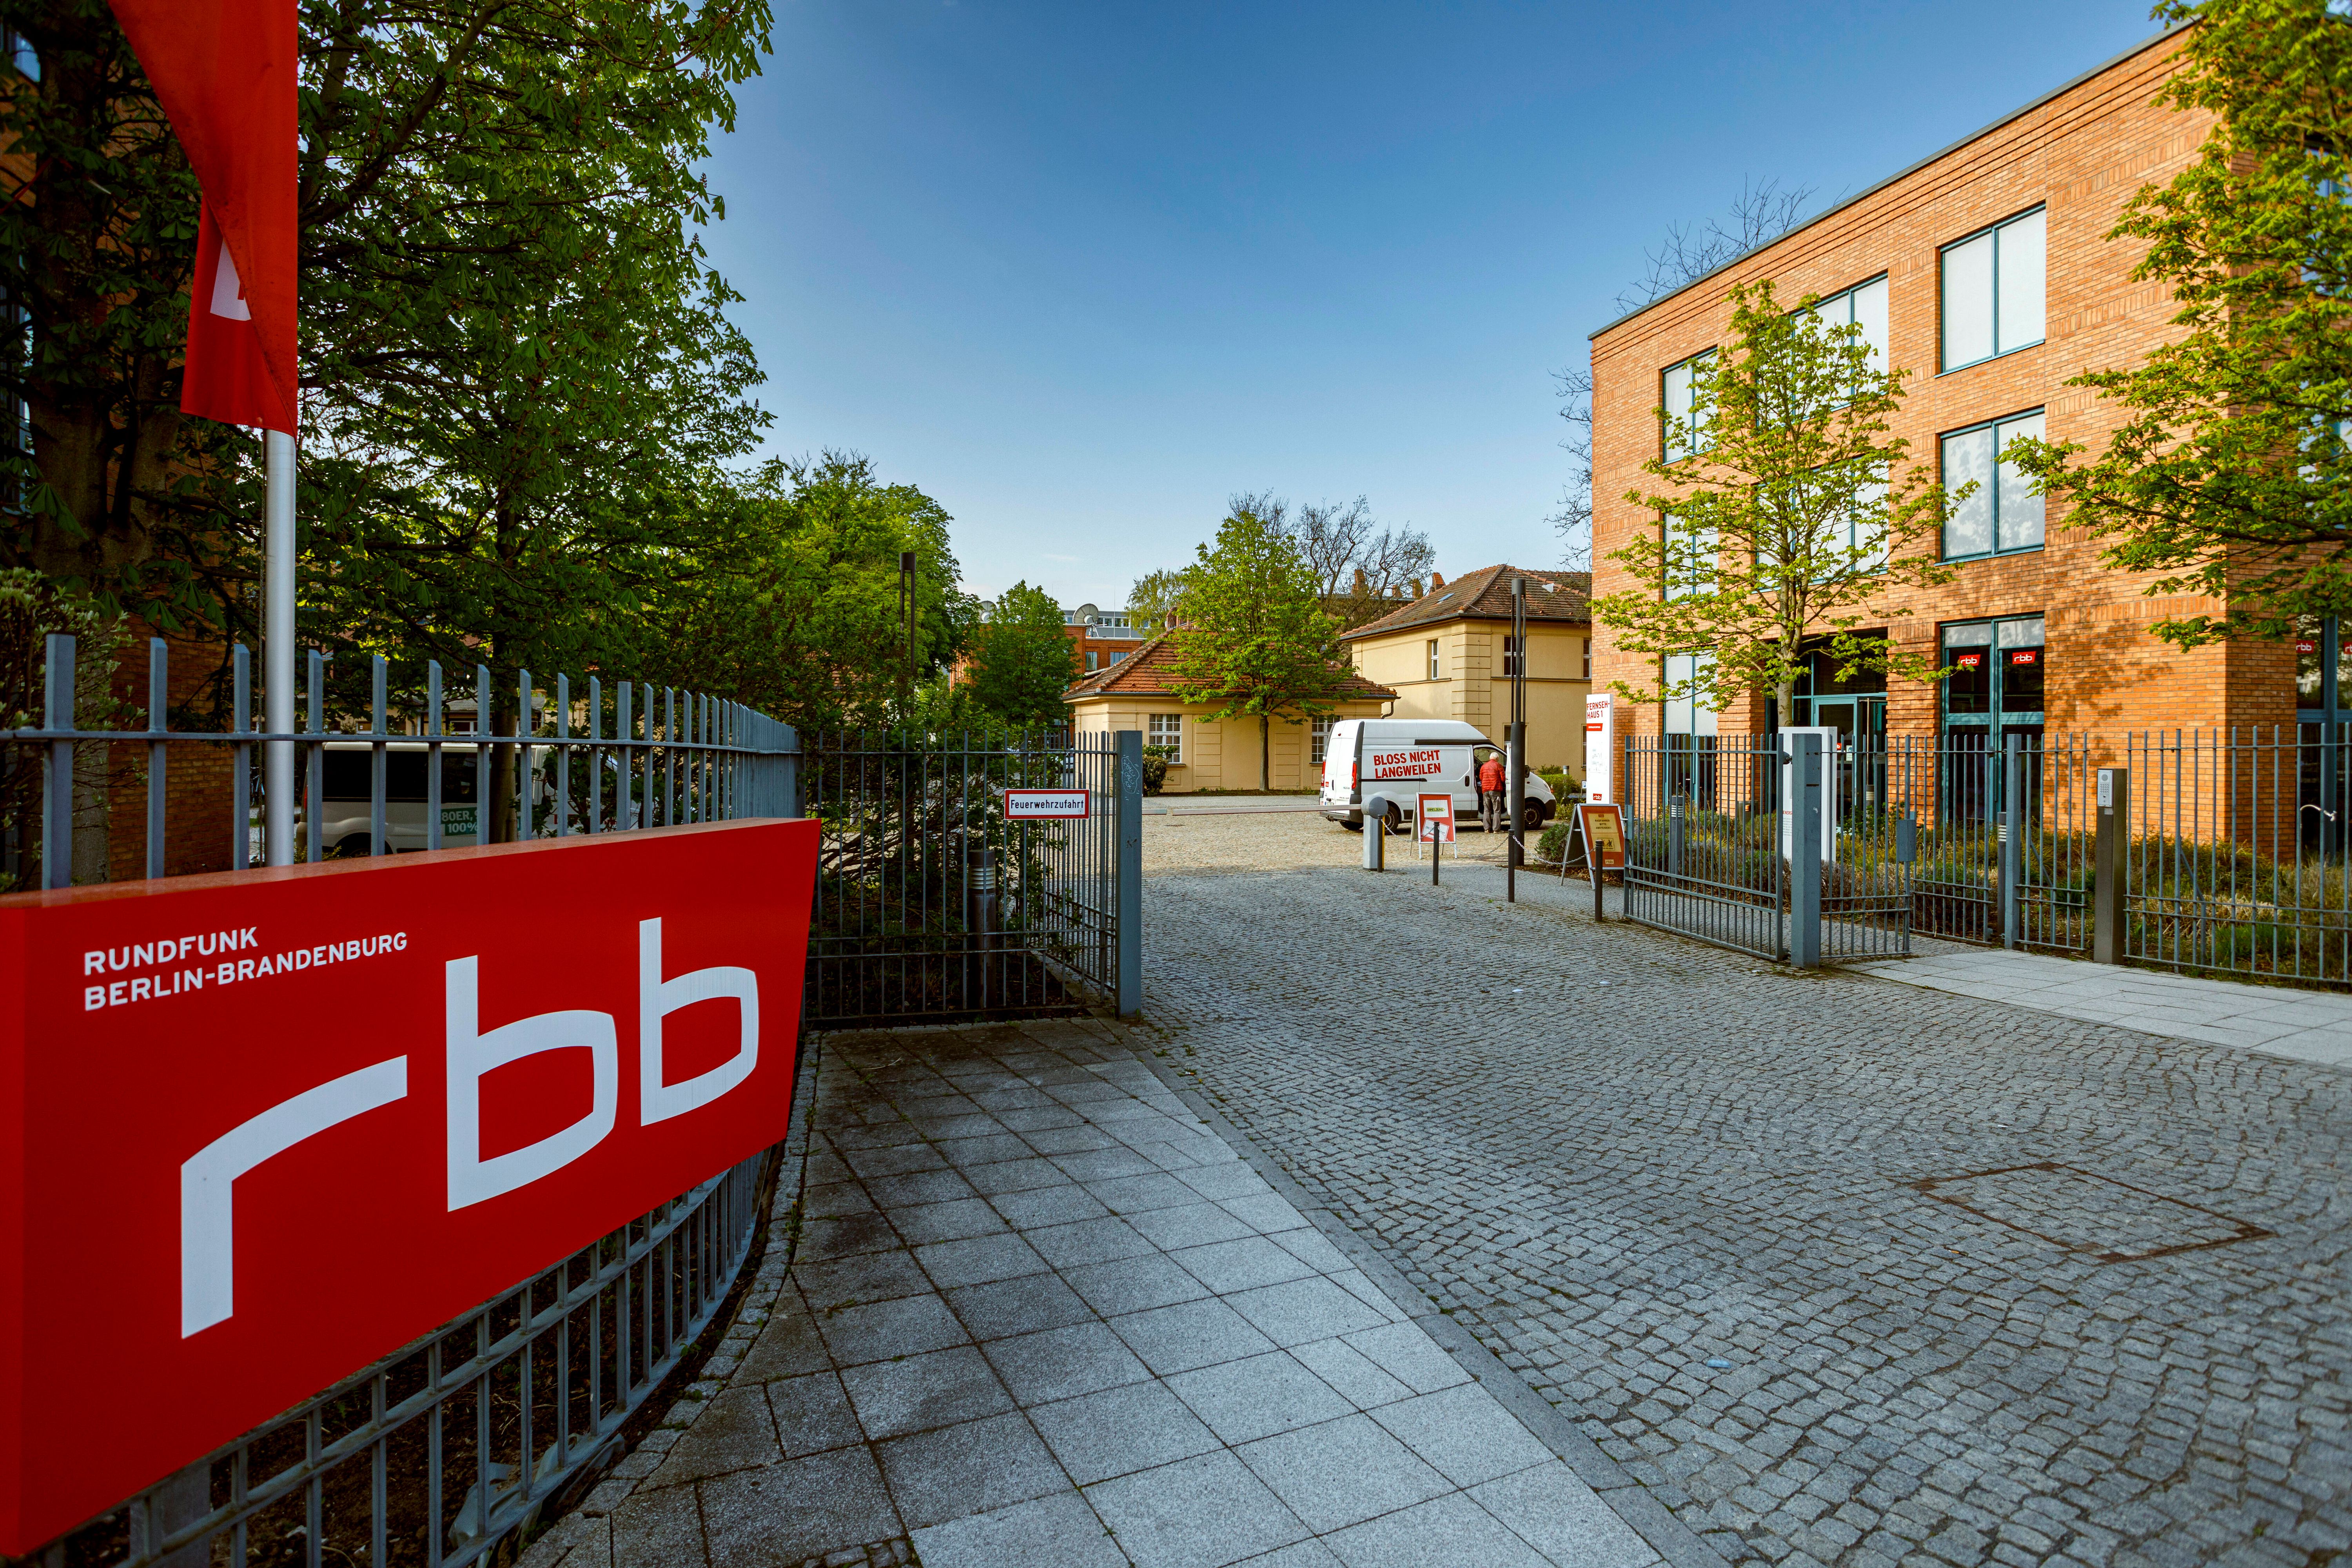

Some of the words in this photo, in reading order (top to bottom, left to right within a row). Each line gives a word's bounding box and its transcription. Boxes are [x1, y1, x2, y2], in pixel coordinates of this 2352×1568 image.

[1586, 701, 1610, 711] FERNSEH-
[1587, 711, 1599, 719] HAUS
[1374, 753, 1407, 766] BLOSS
[1409, 750, 1440, 762] NICHT
[1375, 762, 1441, 779] LANGWEILEN
[1011, 799, 1083, 809] Feuerwehrzufahrt
[441, 810, 473, 822] 80ER,
[447, 822, 477, 833] 100%
[84, 927, 258, 975] RUNDFUNK
[85, 932, 407, 1011] BERLIN-BRANDENBURG
[181, 917, 759, 1339] rbb
